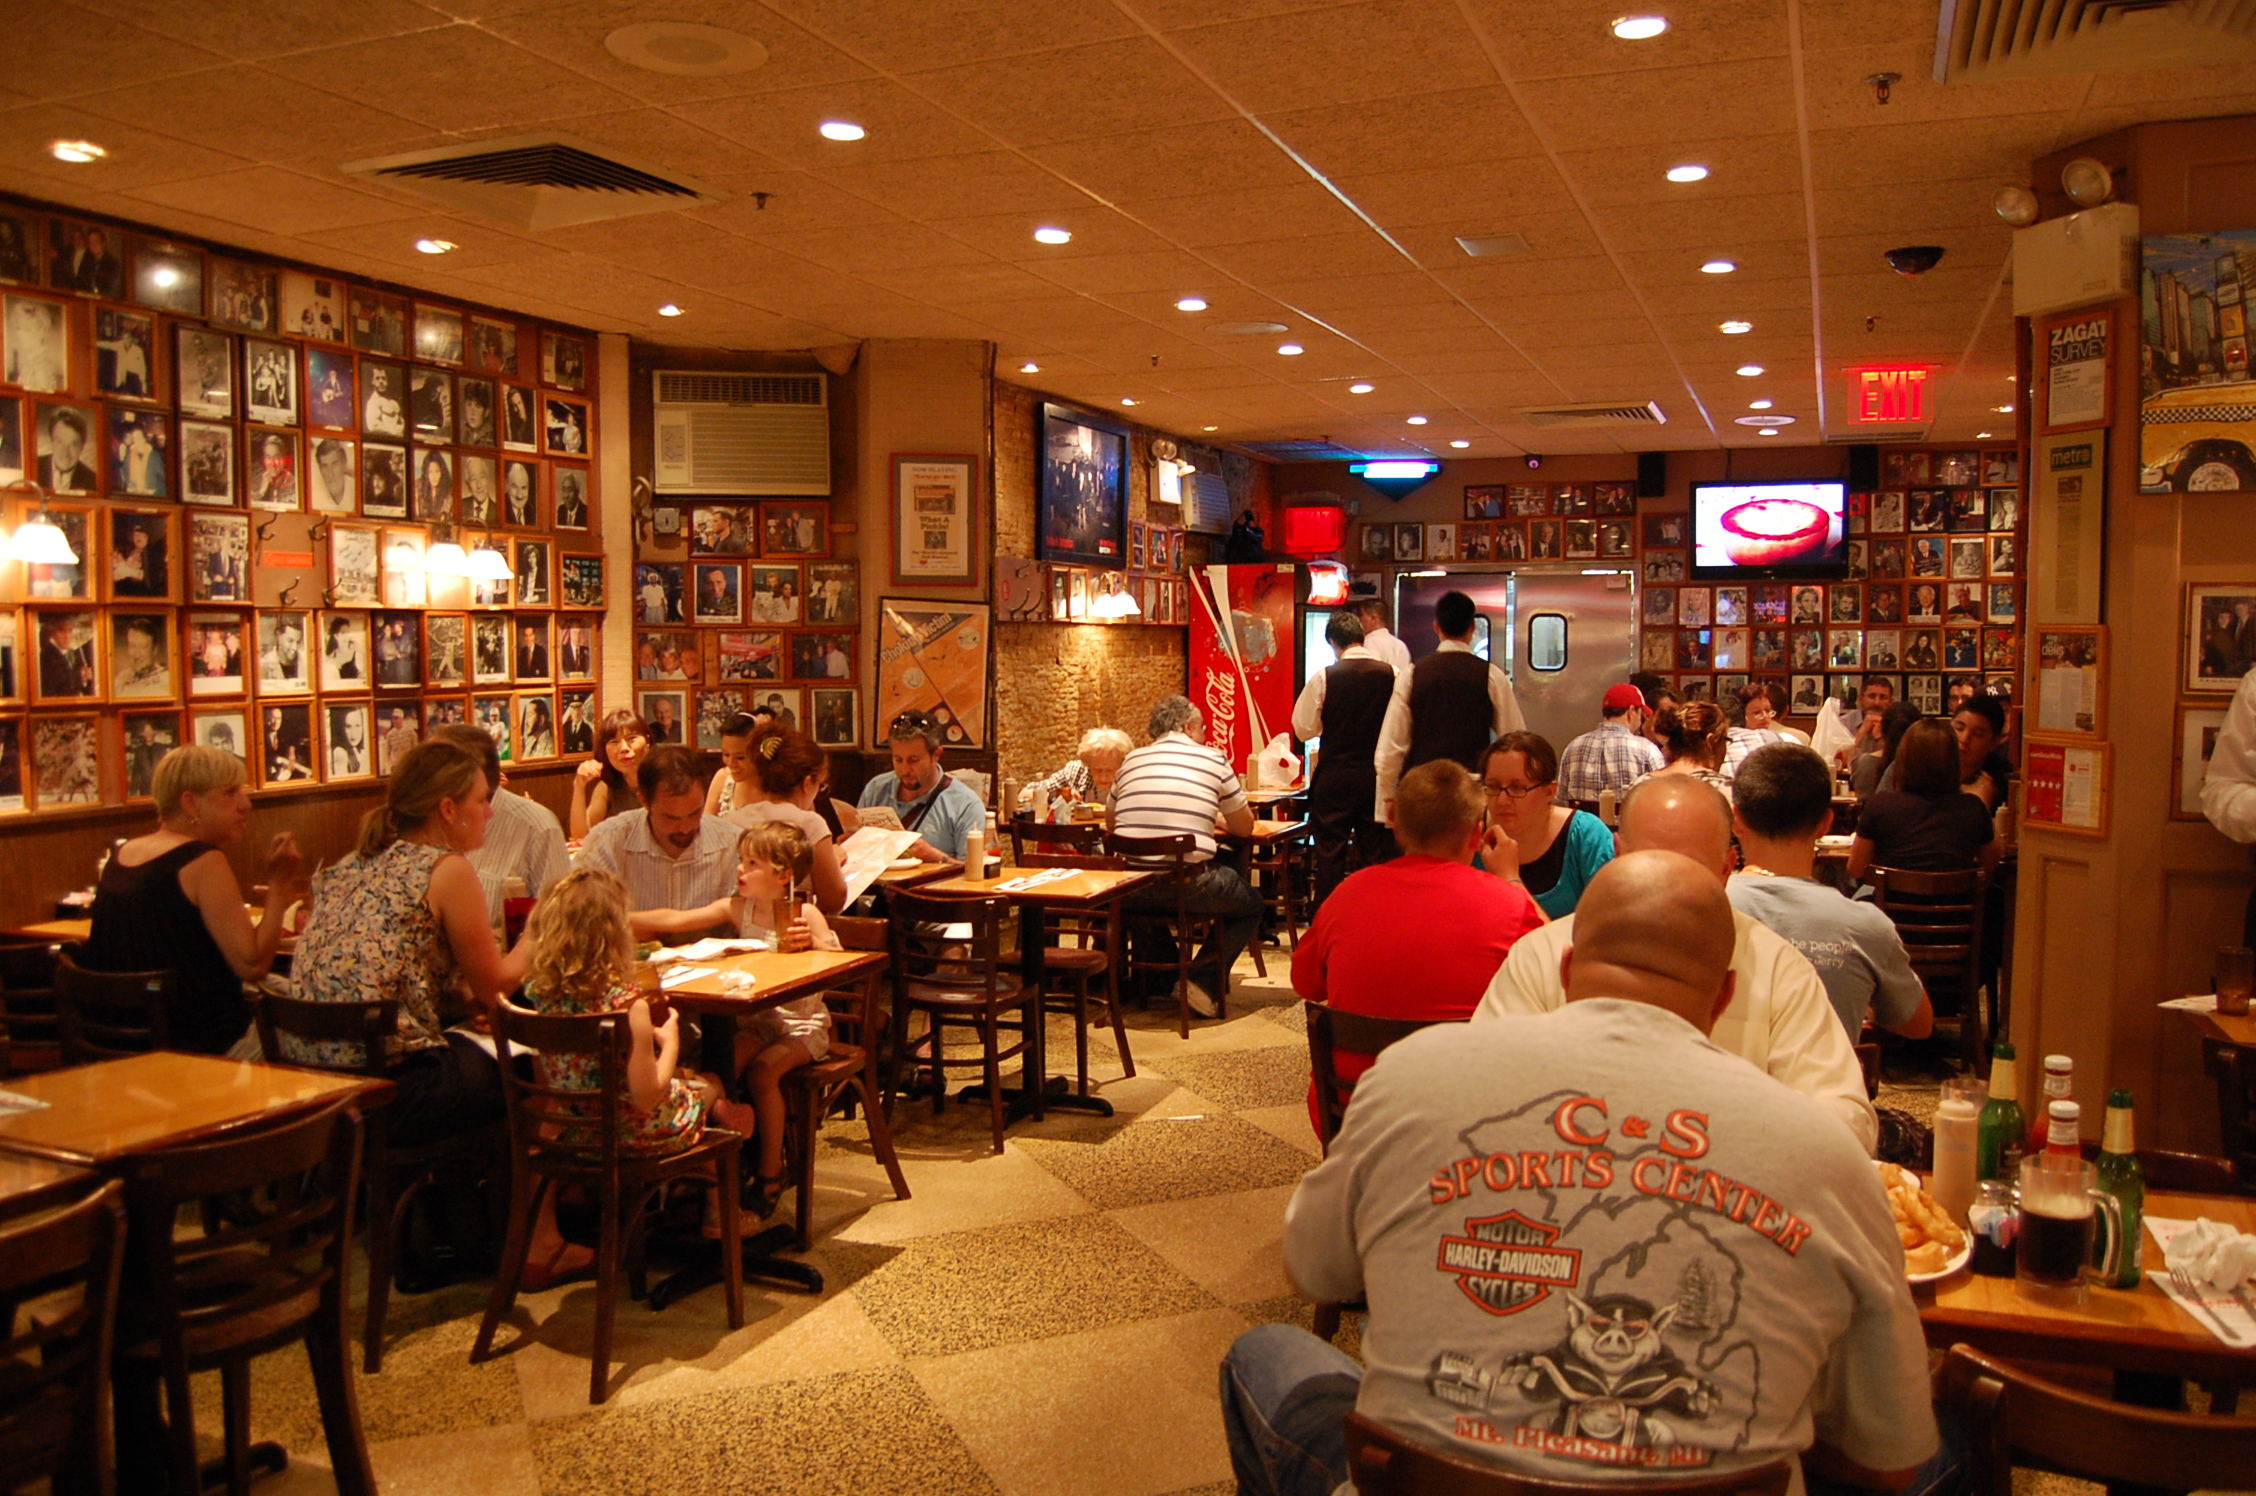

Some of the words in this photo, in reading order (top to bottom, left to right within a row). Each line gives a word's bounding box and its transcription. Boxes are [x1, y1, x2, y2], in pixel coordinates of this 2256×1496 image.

[2051, 320, 2107, 347] ZAGAT
[2051, 340, 2107, 364] SURVEY
[1860, 370, 1927, 421] EXIT
[2052, 448, 2090, 465] metro
[918, 612, 953, 638] Victim
[1790, 938, 1806, 949] he
[1810, 940, 1853, 955] people
[1814, 955, 1845, 968] Jerry
[1554, 1097, 1610, 1146] C
[1620, 1115, 1650, 1139] &
[1659, 1109, 1711, 1159] S
[1429, 1151, 1614, 1204] SPORTS
[1631, 1157, 1813, 1257] CENTER
[1475, 1223, 1545, 1246] MOTOR
[1444, 1242, 1573, 1280] HARLEY-DAVIDSON
[1467, 1276, 1537, 1301] CYCLES
[1455, 1415, 1505, 1445] Mt.
